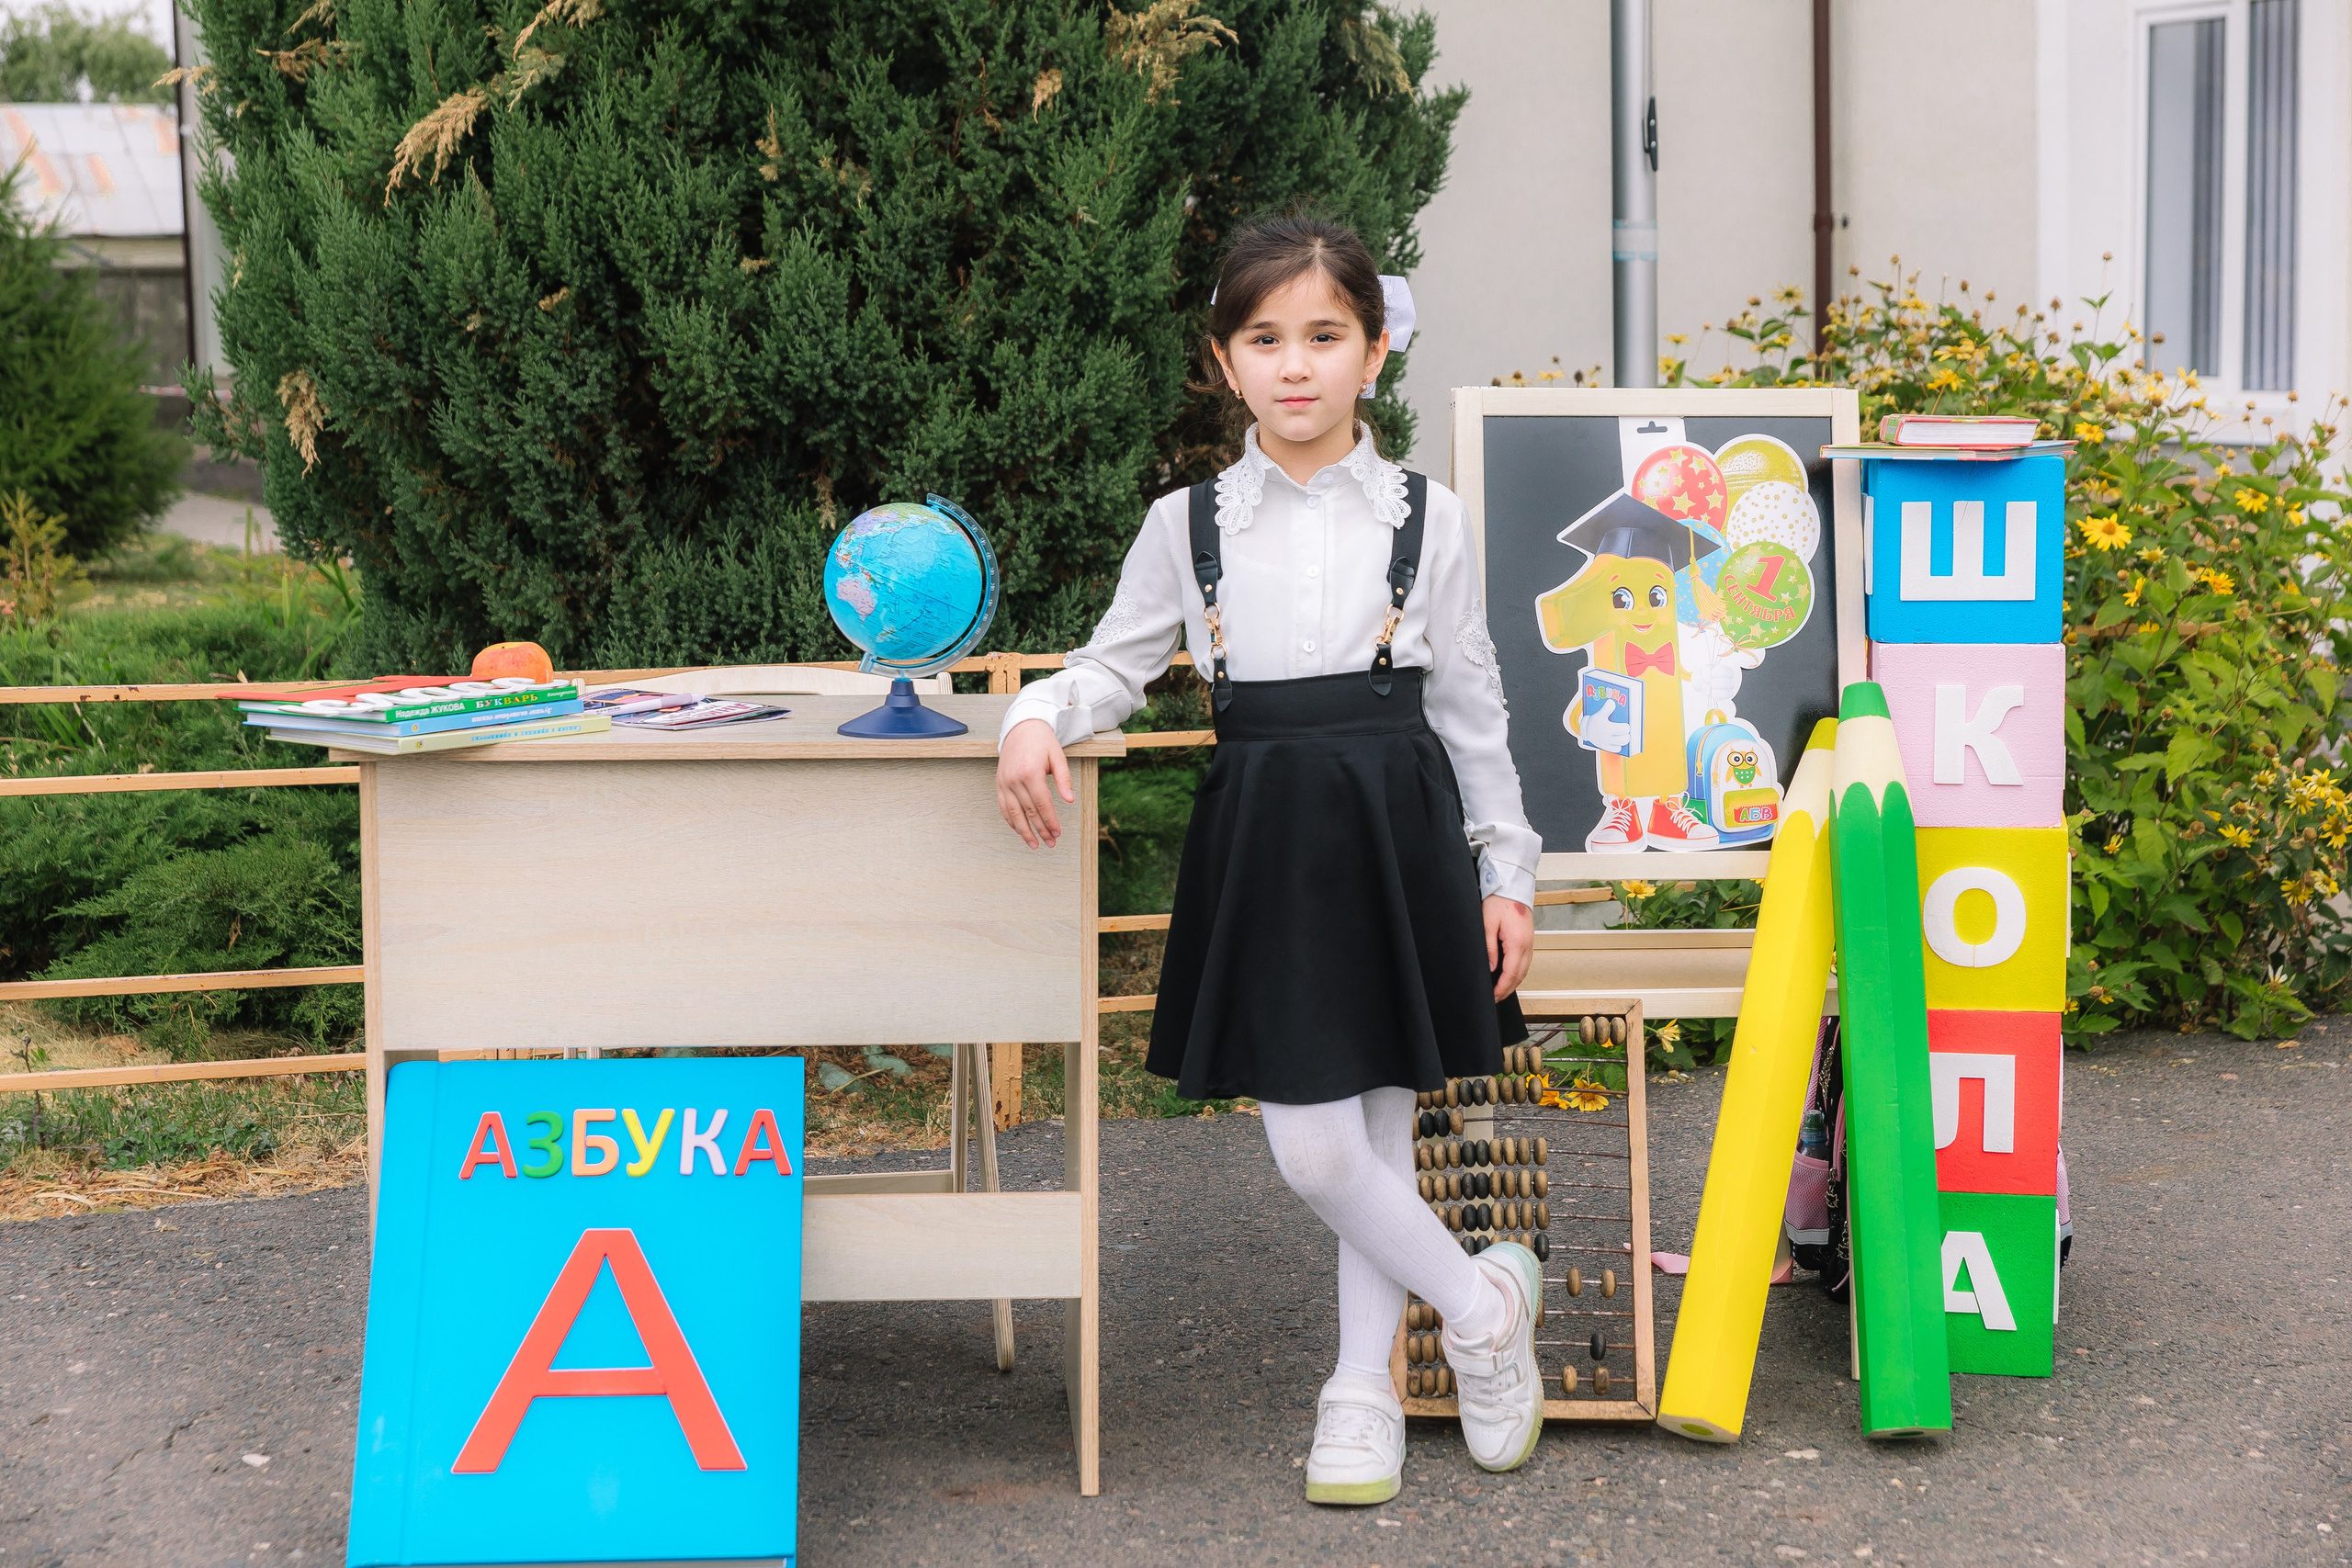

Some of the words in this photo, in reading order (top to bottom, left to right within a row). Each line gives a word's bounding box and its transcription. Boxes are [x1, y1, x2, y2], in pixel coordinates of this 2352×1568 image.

[1724, 574, 1796, 622] СЕНТЯБРЯ
[1745, 555, 1786, 603] 1
[395, 707, 430, 719] Надежда
[431, 703, 466, 716] ЖУКОВА
[475, 694, 538, 709] БУКВАРЬ
[1739, 807, 1773, 821] АБВ
[458, 1108, 792, 1179] АЗБУКА
[451, 1228, 748, 1473] А
